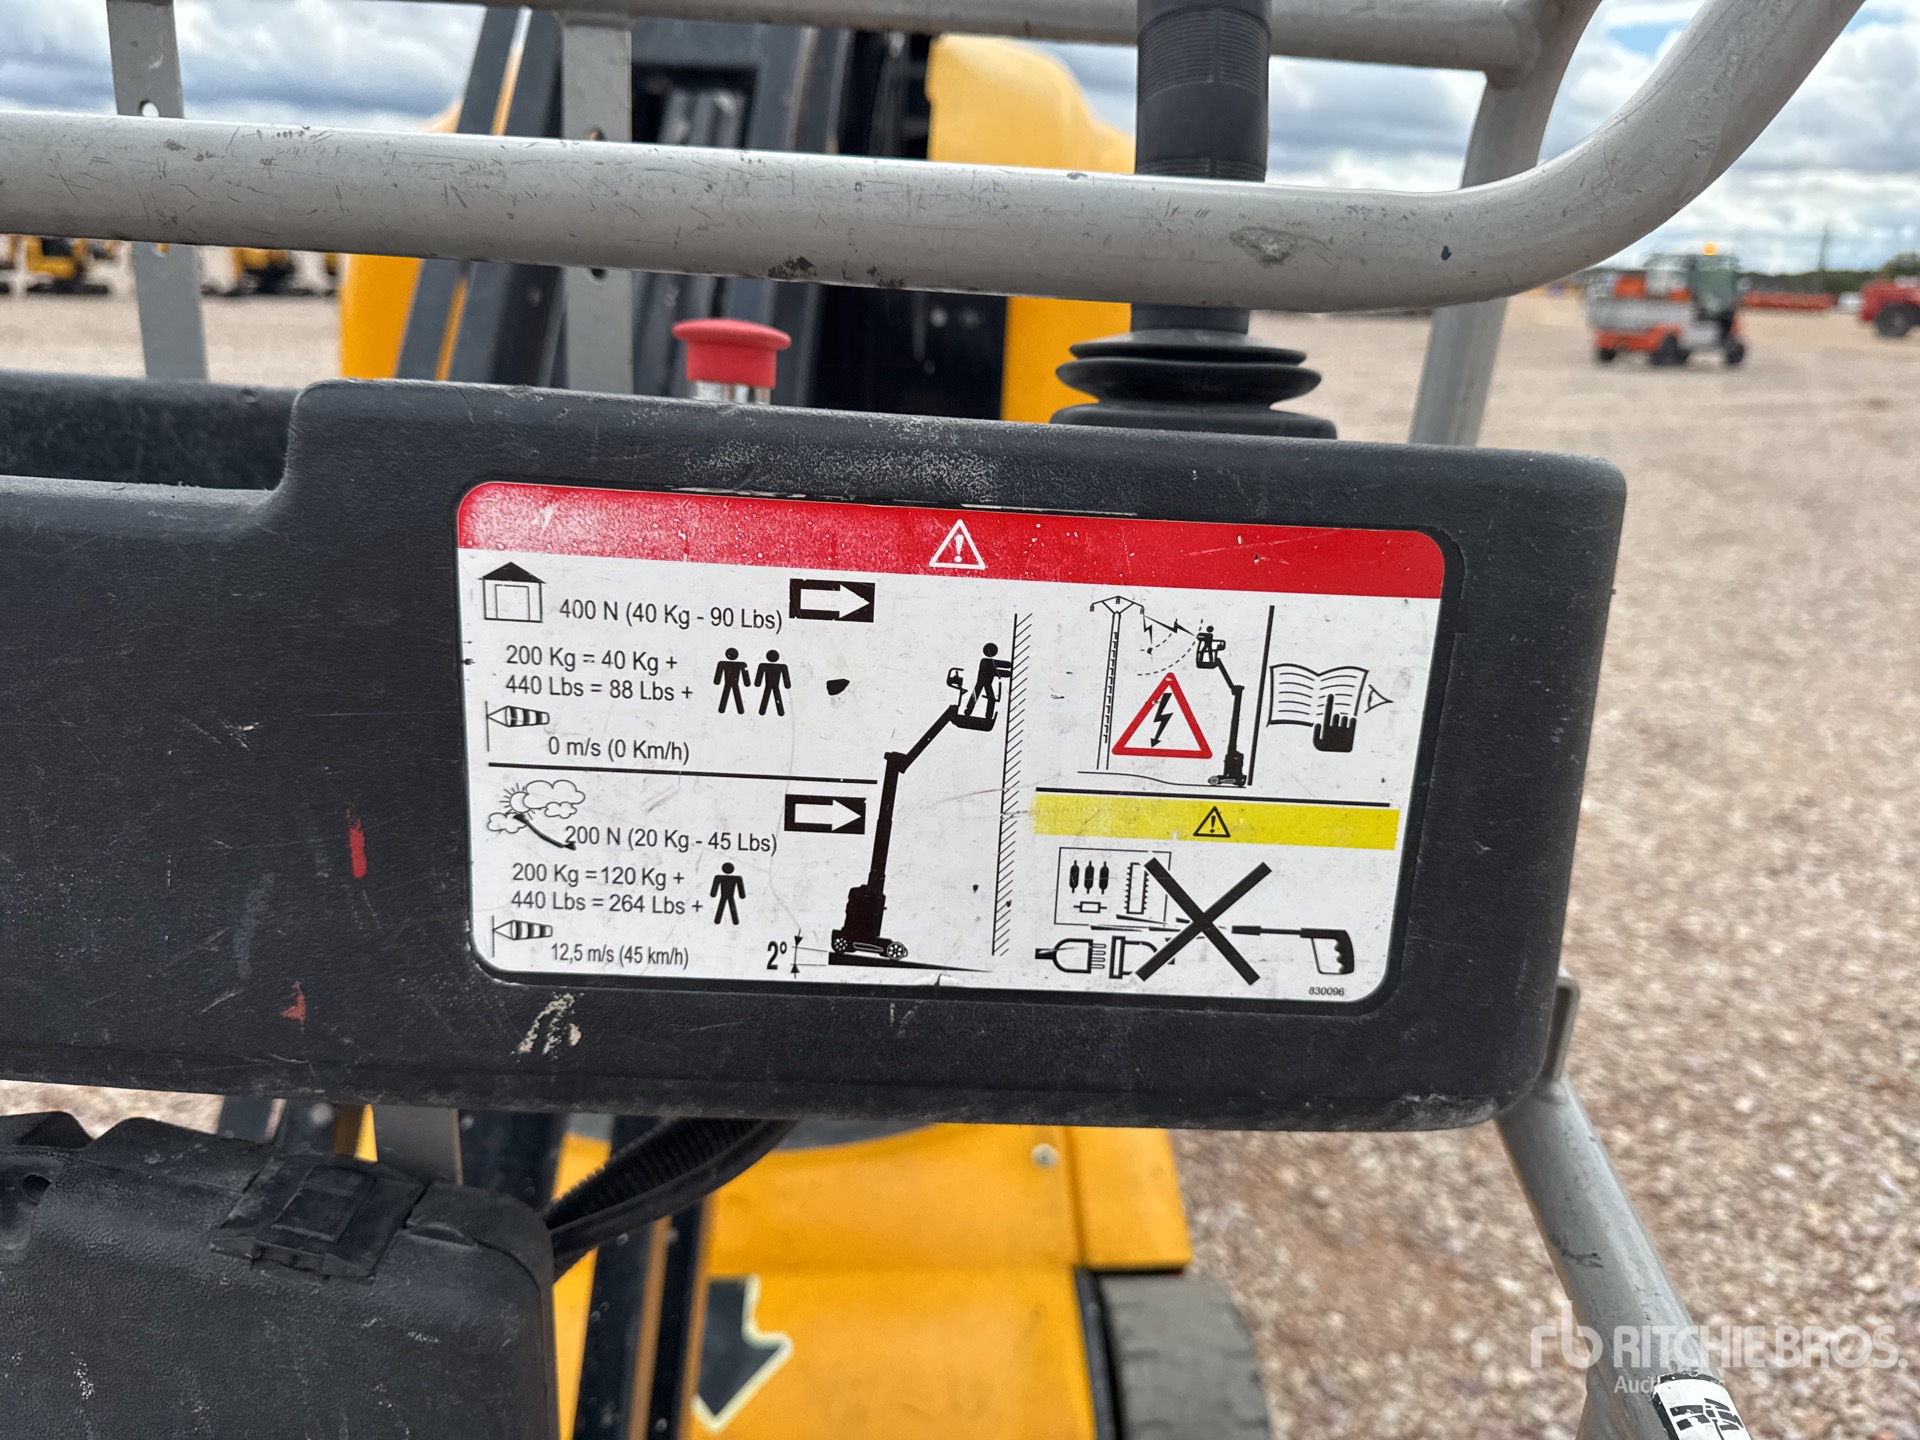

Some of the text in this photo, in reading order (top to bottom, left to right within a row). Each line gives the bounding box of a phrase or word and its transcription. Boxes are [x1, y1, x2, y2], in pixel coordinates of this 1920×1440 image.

[560, 598, 596, 620] 400
[604, 600, 618, 621] N
[625, 602, 657, 627] (40
[664, 604, 690, 630] Kg
[710, 606, 734, 628] 90
[741, 608, 783, 635] Lbs)
[506, 644, 678, 677] 200 Kg = 40 Kg +
[505, 674, 694, 702] 440 Lbs = 88 Lbs +
[548, 736, 690, 766] 0 m/s (0 Km/h)
[564, 825, 600, 846] 200
[607, 827, 621, 846] N
[628, 827, 658, 851] (20
[664, 829, 689, 854] Kg
[707, 831, 732, 851] 45
[737, 832, 777, 857] Lbs)
[512, 862, 547, 882] 200
[554, 864, 579, 888] Kg
[585, 870, 597, 879] =
[641, 867, 667, 891] Kg
[673, 872, 685, 885] +
[511, 890, 703, 915] 440 Lbs = 264 Lbs +
[551, 942, 689, 970] 12,5 m/s (45 km/h)
[1308, 986, 1345, 996] 830096
